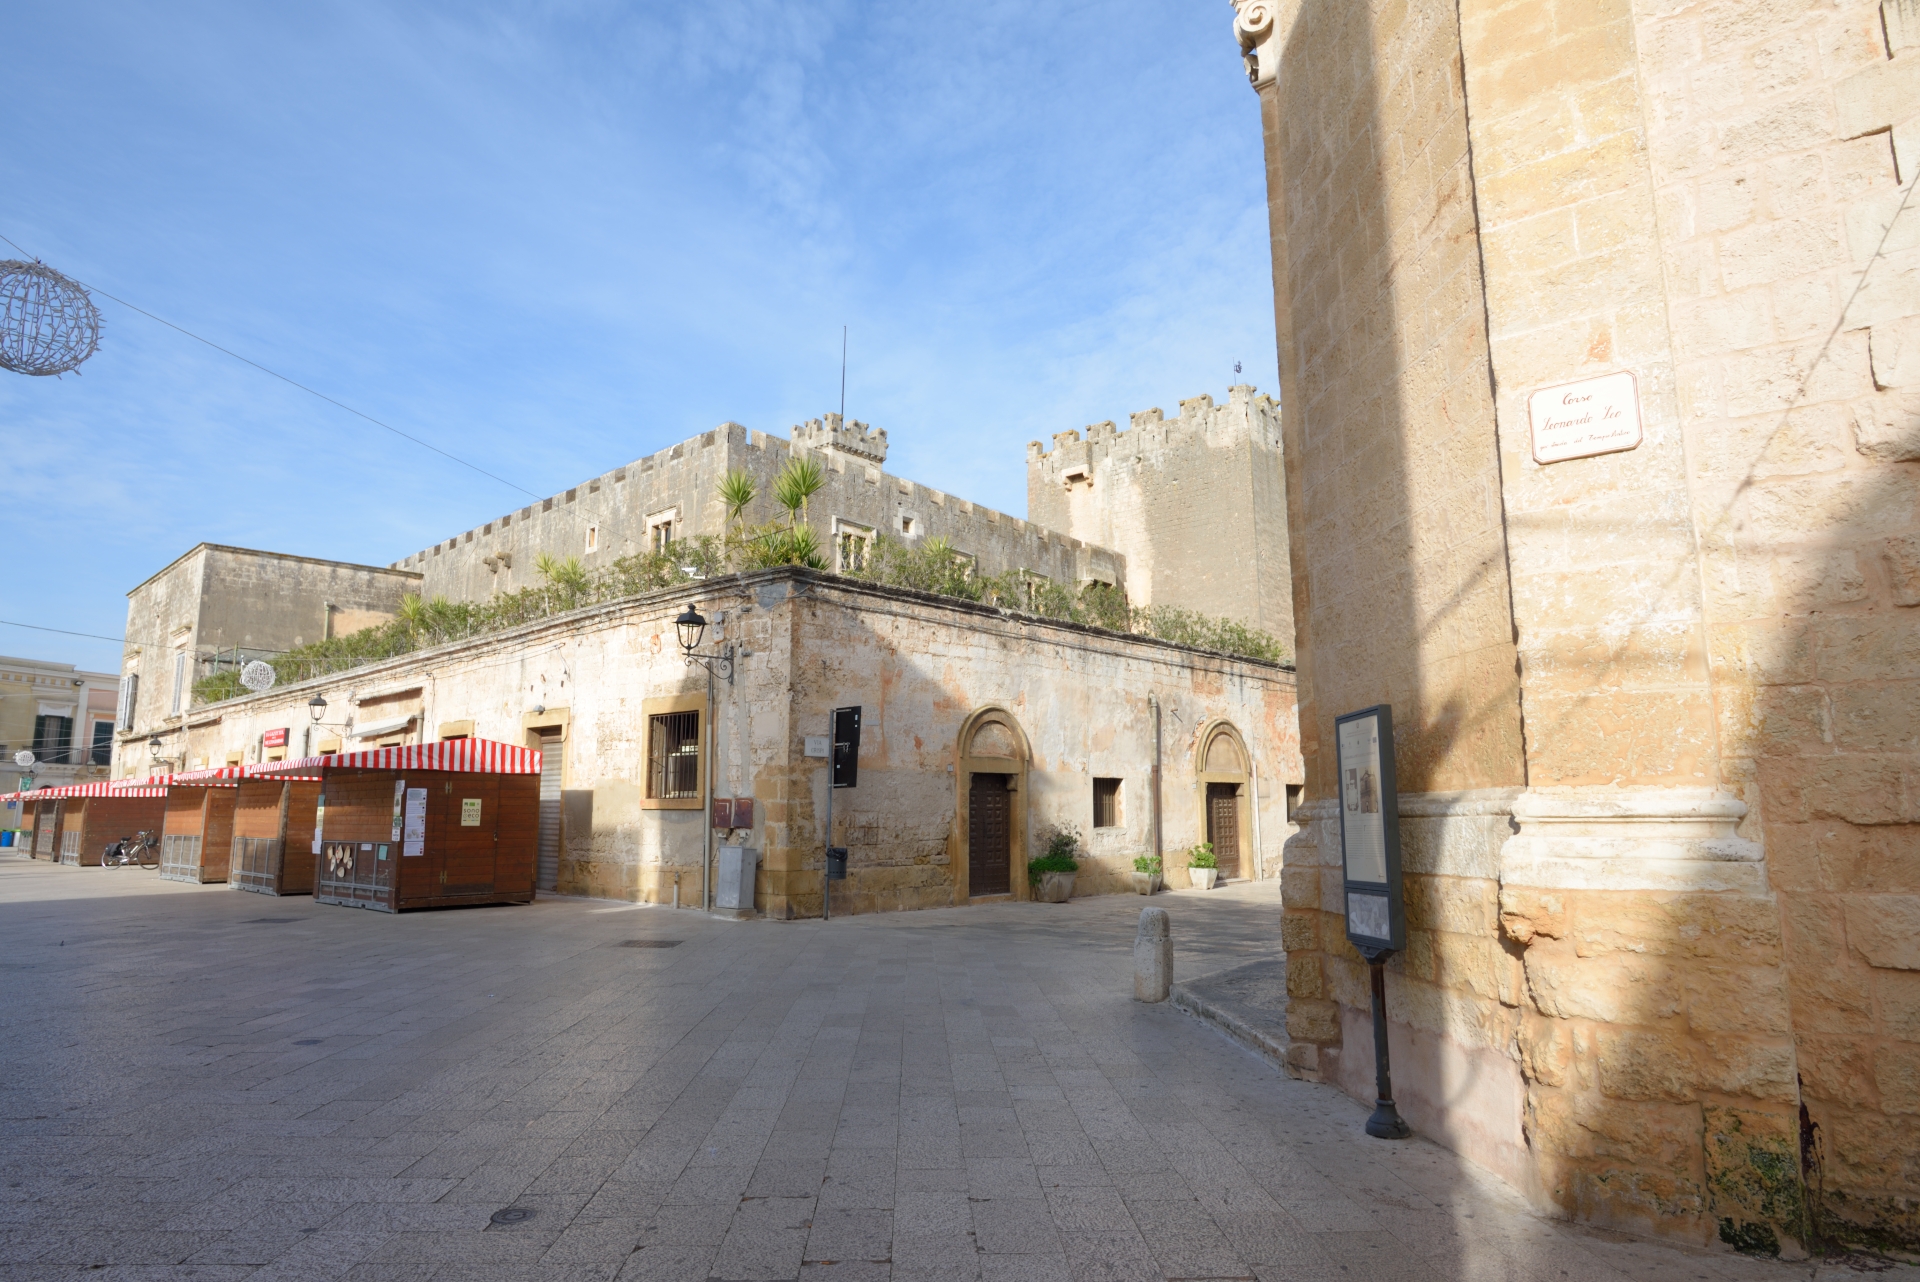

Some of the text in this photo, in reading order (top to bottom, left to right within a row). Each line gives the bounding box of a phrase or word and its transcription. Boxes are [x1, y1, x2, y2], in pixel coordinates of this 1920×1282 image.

[1562, 392, 1593, 405] Corso
[1541, 405, 1622, 431] Leonardo Leo
